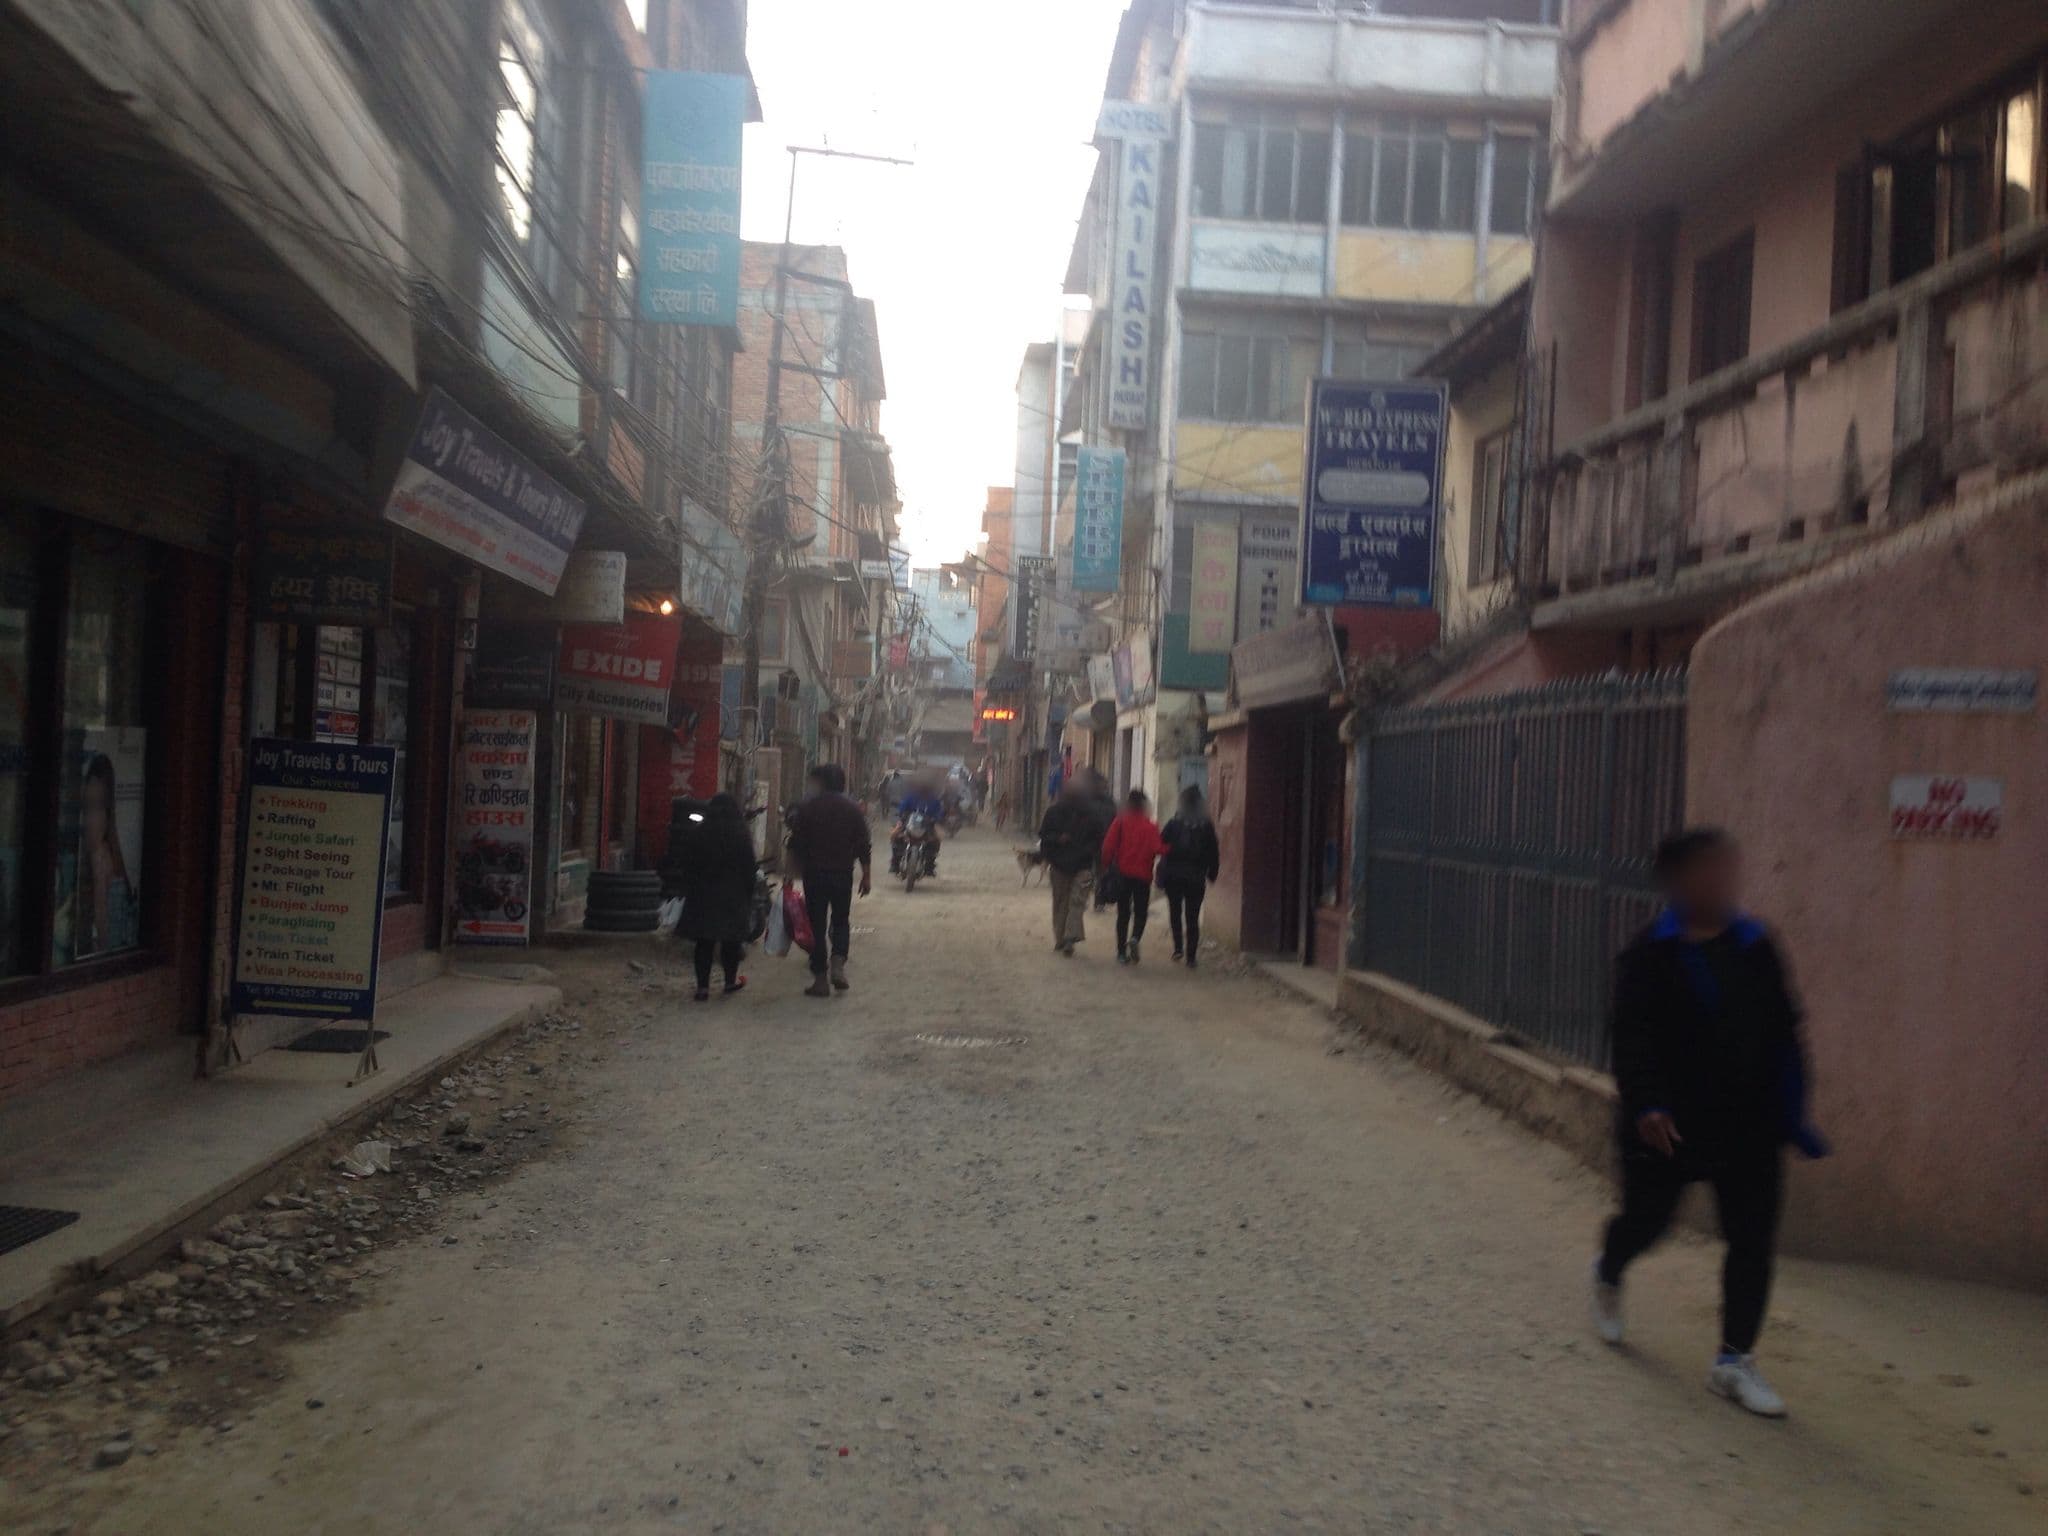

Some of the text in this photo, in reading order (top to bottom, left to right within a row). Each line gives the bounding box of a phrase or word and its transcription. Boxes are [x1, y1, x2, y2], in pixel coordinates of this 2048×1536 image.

[1118, 142, 1153, 386] KAILASH
[1324, 430, 1429, 451] TRAVELS
[419, 410, 458, 468] Joy
[456, 427, 506, 492] Travels
[516, 472, 549, 521] Tours
[1252, 524, 1293, 541] FOUR
[570, 647, 664, 682] EXIDE
[586, 691, 665, 714] Accessories
[256, 749, 390, 776] Joy Travels & Tours
[271, 797, 328, 812] Trekking
[267, 813, 316, 829] Rafting
[265, 831, 355, 847] Jungle Safari
[264, 847, 351, 866] Sight Seeing
[263, 864, 356, 881] Package Tour
[287, 881, 326, 897] Flight
[311, 900, 350, 915] Jump
[260, 914, 337, 931] Paragliding
[290, 932, 330, 946] Ticket
[257, 948, 337, 964] Train Ticket
[255, 964, 365, 984] Visa Processing
